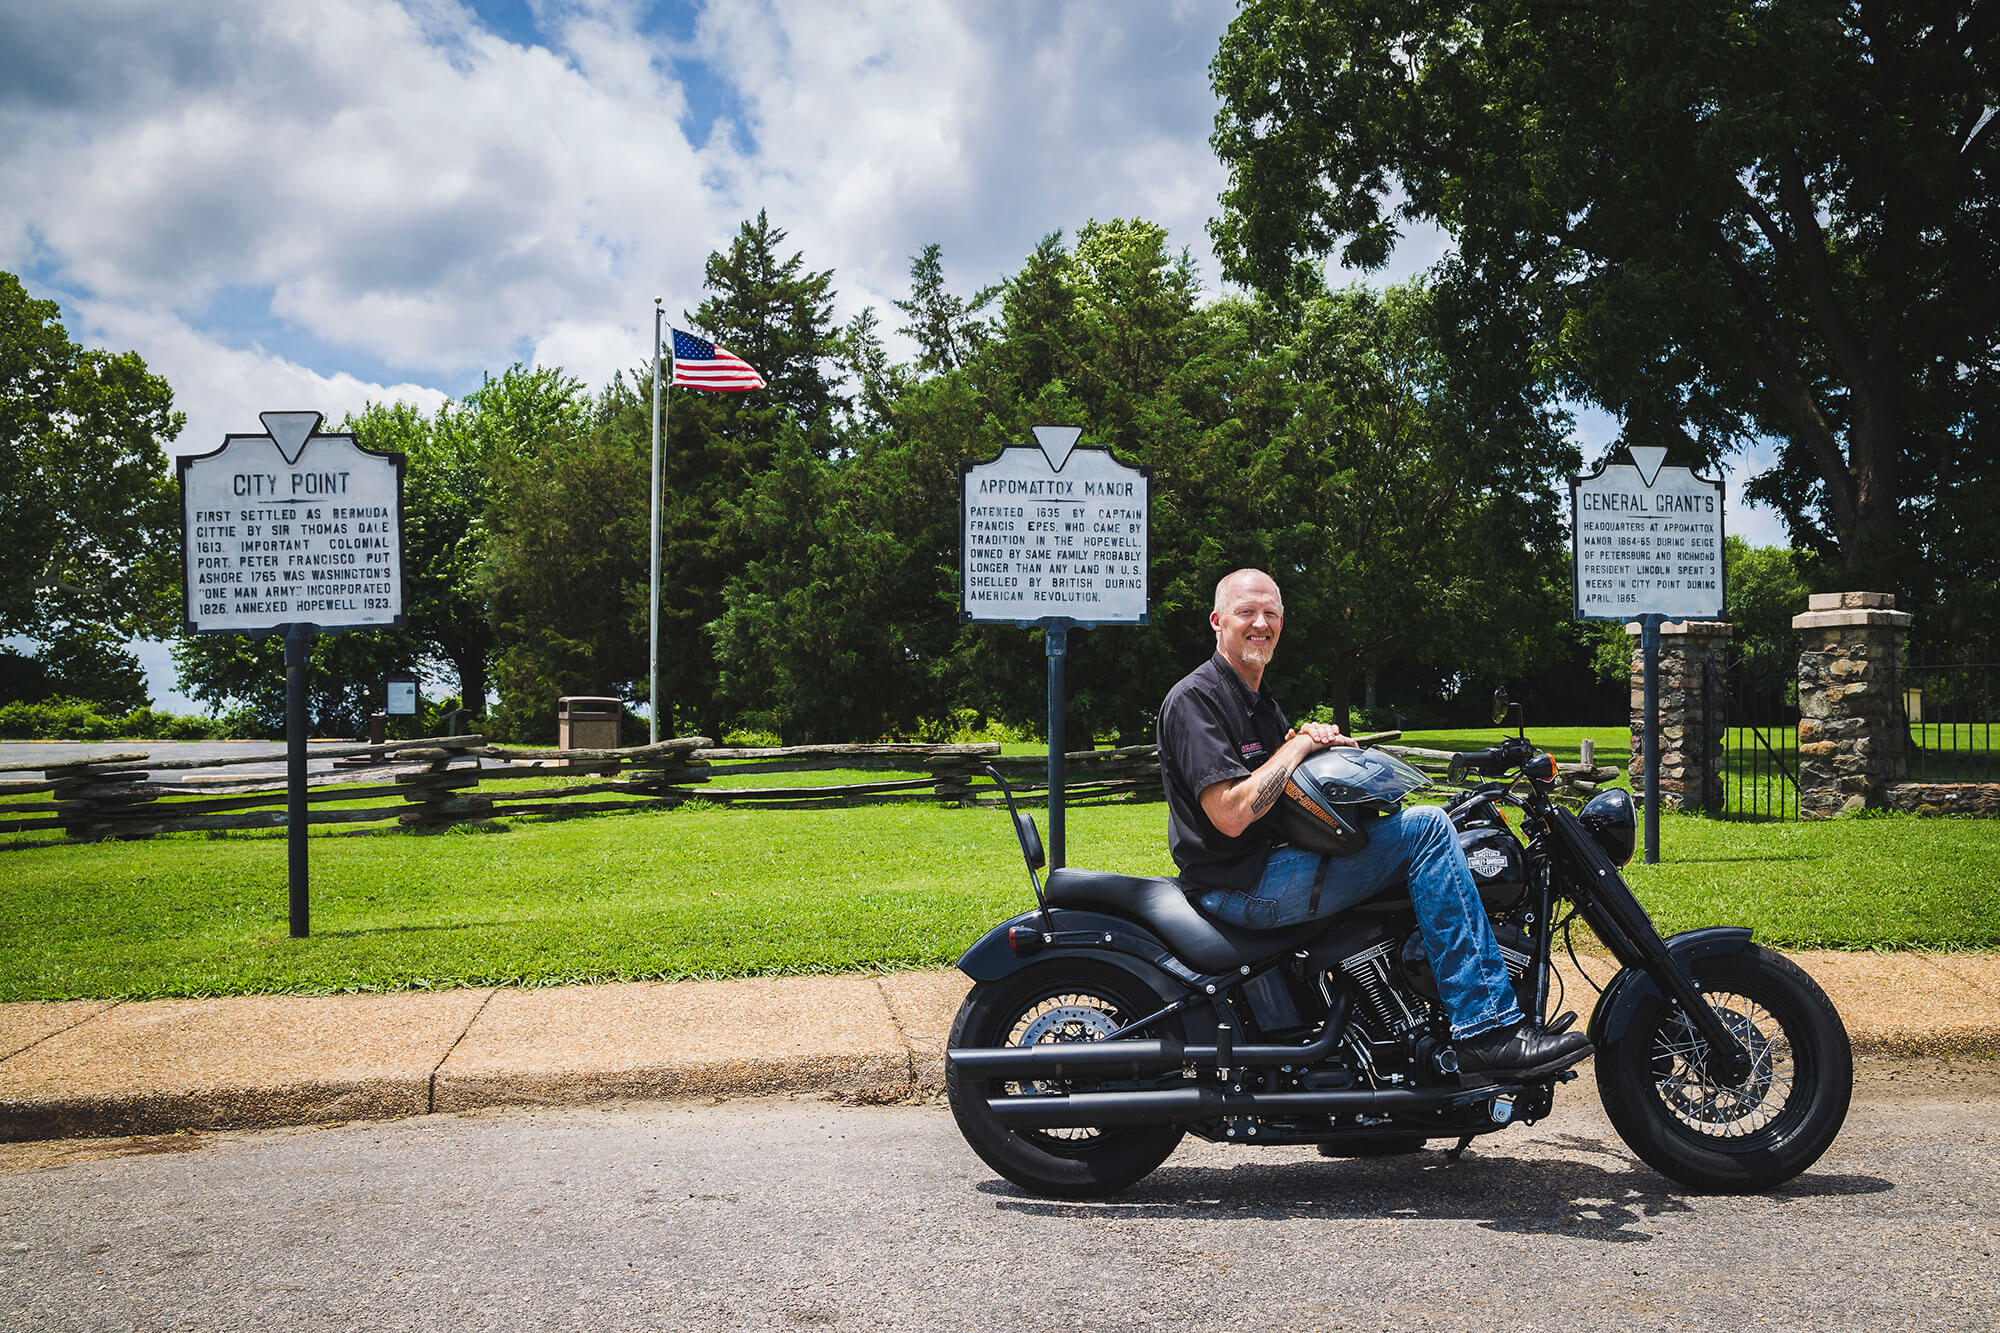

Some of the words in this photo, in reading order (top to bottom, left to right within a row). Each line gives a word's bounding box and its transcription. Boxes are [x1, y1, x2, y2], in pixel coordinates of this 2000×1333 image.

[233, 474, 277, 496] CITY
[291, 472, 350, 494] POINT
[979, 480, 1073, 496] APPOMATTOX
[1085, 482, 1133, 496] MANOR
[1583, 493, 1648, 511] GENERAL
[1656, 495, 1714, 512] GRANT'S
[196, 511, 231, 522] FIRST
[241, 510, 296, 521] SETTLED
[306, 509, 321, 519] AS
[333, 508, 389, 518] BERMUDA
[970, 507, 1024, 517] PATENTED
[1036, 508, 1060, 517] 1635
[1072, 509, 1085, 518] BY
[1099, 509, 1141, 519] CAPTAIN
[196, 526, 236, 537] CITTIE
[247, 526, 261, 535] BY
[272, 525, 290, 535] SIR
[301, 524, 347, 534] THOMAS
[359, 523, 389, 533] DALE
[970, 521, 1014, 531] FRANCIS
[1065, 523, 1085, 531] WHO
[1093, 523, 1120, 533] CAME
[1129, 524, 1141, 533] BY
[1584, 522, 1645, 531] HEADQUARTERS
[1650, 523, 1658, 532] AT
[1664, 523, 1714, 533] APPOMATTOX
[241, 540, 310, 551] IMPORTANT
[329, 538, 389, 550] COLONIAL
[970, 535, 1025, 545] TRADITION
[1036, 536, 1045, 545] IN
[1055, 536, 1073, 546] THE
[1084, 537, 1141, 547] HOPEWELL.
[1584, 536, 1612, 545] MANOR
[1618, 537, 1650, 546] 1864-65
[1657, 538, 1685, 547] DURING
[1691, 539, 1714, 547] SEIGE
[198, 557, 231, 568] PORT.
[239, 556, 278, 566] PETER
[289, 554, 355, 566] FRANCISCO
[366, 553, 390, 563] PUT
[970, 549, 1003, 559] OWNED
[1009, 549, 1020, 559] BY
[1025, 550, 1051, 559] SAME
[1057, 550, 1088, 560] FAMILY
[1094, 551, 1141, 561] PROBABLY
[1585, 551, 1593, 559] OF
[1600, 551, 1651, 560] PETERSBURG
[1656, 552, 1671, 561] AND
[1677, 552, 1714, 561] RICHMOND
[970, 563, 1009, 573] LONGER
[1016, 564, 1041, 573] THAN
[1049, 564, 1067, 574] ANY
[1074, 565, 1099, 574] LAND
[1106, 565, 1115, 574] IN
[1585, 565, 1630, 574] PRESIDENT
[1637, 566, 1670, 574] LINCOLN
[1678, 566, 1703, 575] SPENT
[1710, 567, 1715, 575] 3
[199, 572, 243, 584] ASHORE
[251, 571, 276, 582] 1765
[283, 570, 305, 581] WAS
[312, 568, 390, 580] WASHINGTON'S
[970, 577, 1017, 587] SHELLED
[1029, 578, 1041, 588] BY
[1052, 578, 1093, 588] BRITISH
[1105, 579, 1141, 589] DURING
[1585, 580, 1613, 588] WEEKS
[1618, 580, 1626, 588] IN
[1631, 580, 1650, 588] CITY
[1657, 580, 1680, 589] POINT
[1687, 581, 1715, 589] DURING
[234, 588, 257, 598] MAN
[307, 583, 391, 596] INCORPORATED
[970, 591, 1024, 601] AMERICAN
[1034, 592, 1101, 602] REVOLUTION.
[200, 604, 228, 615] 1826.
[235, 602, 287, 613] ANNEXED
[297, 600, 356, 612] HOPEWELL
[364, 599, 392, 609] 1923.
